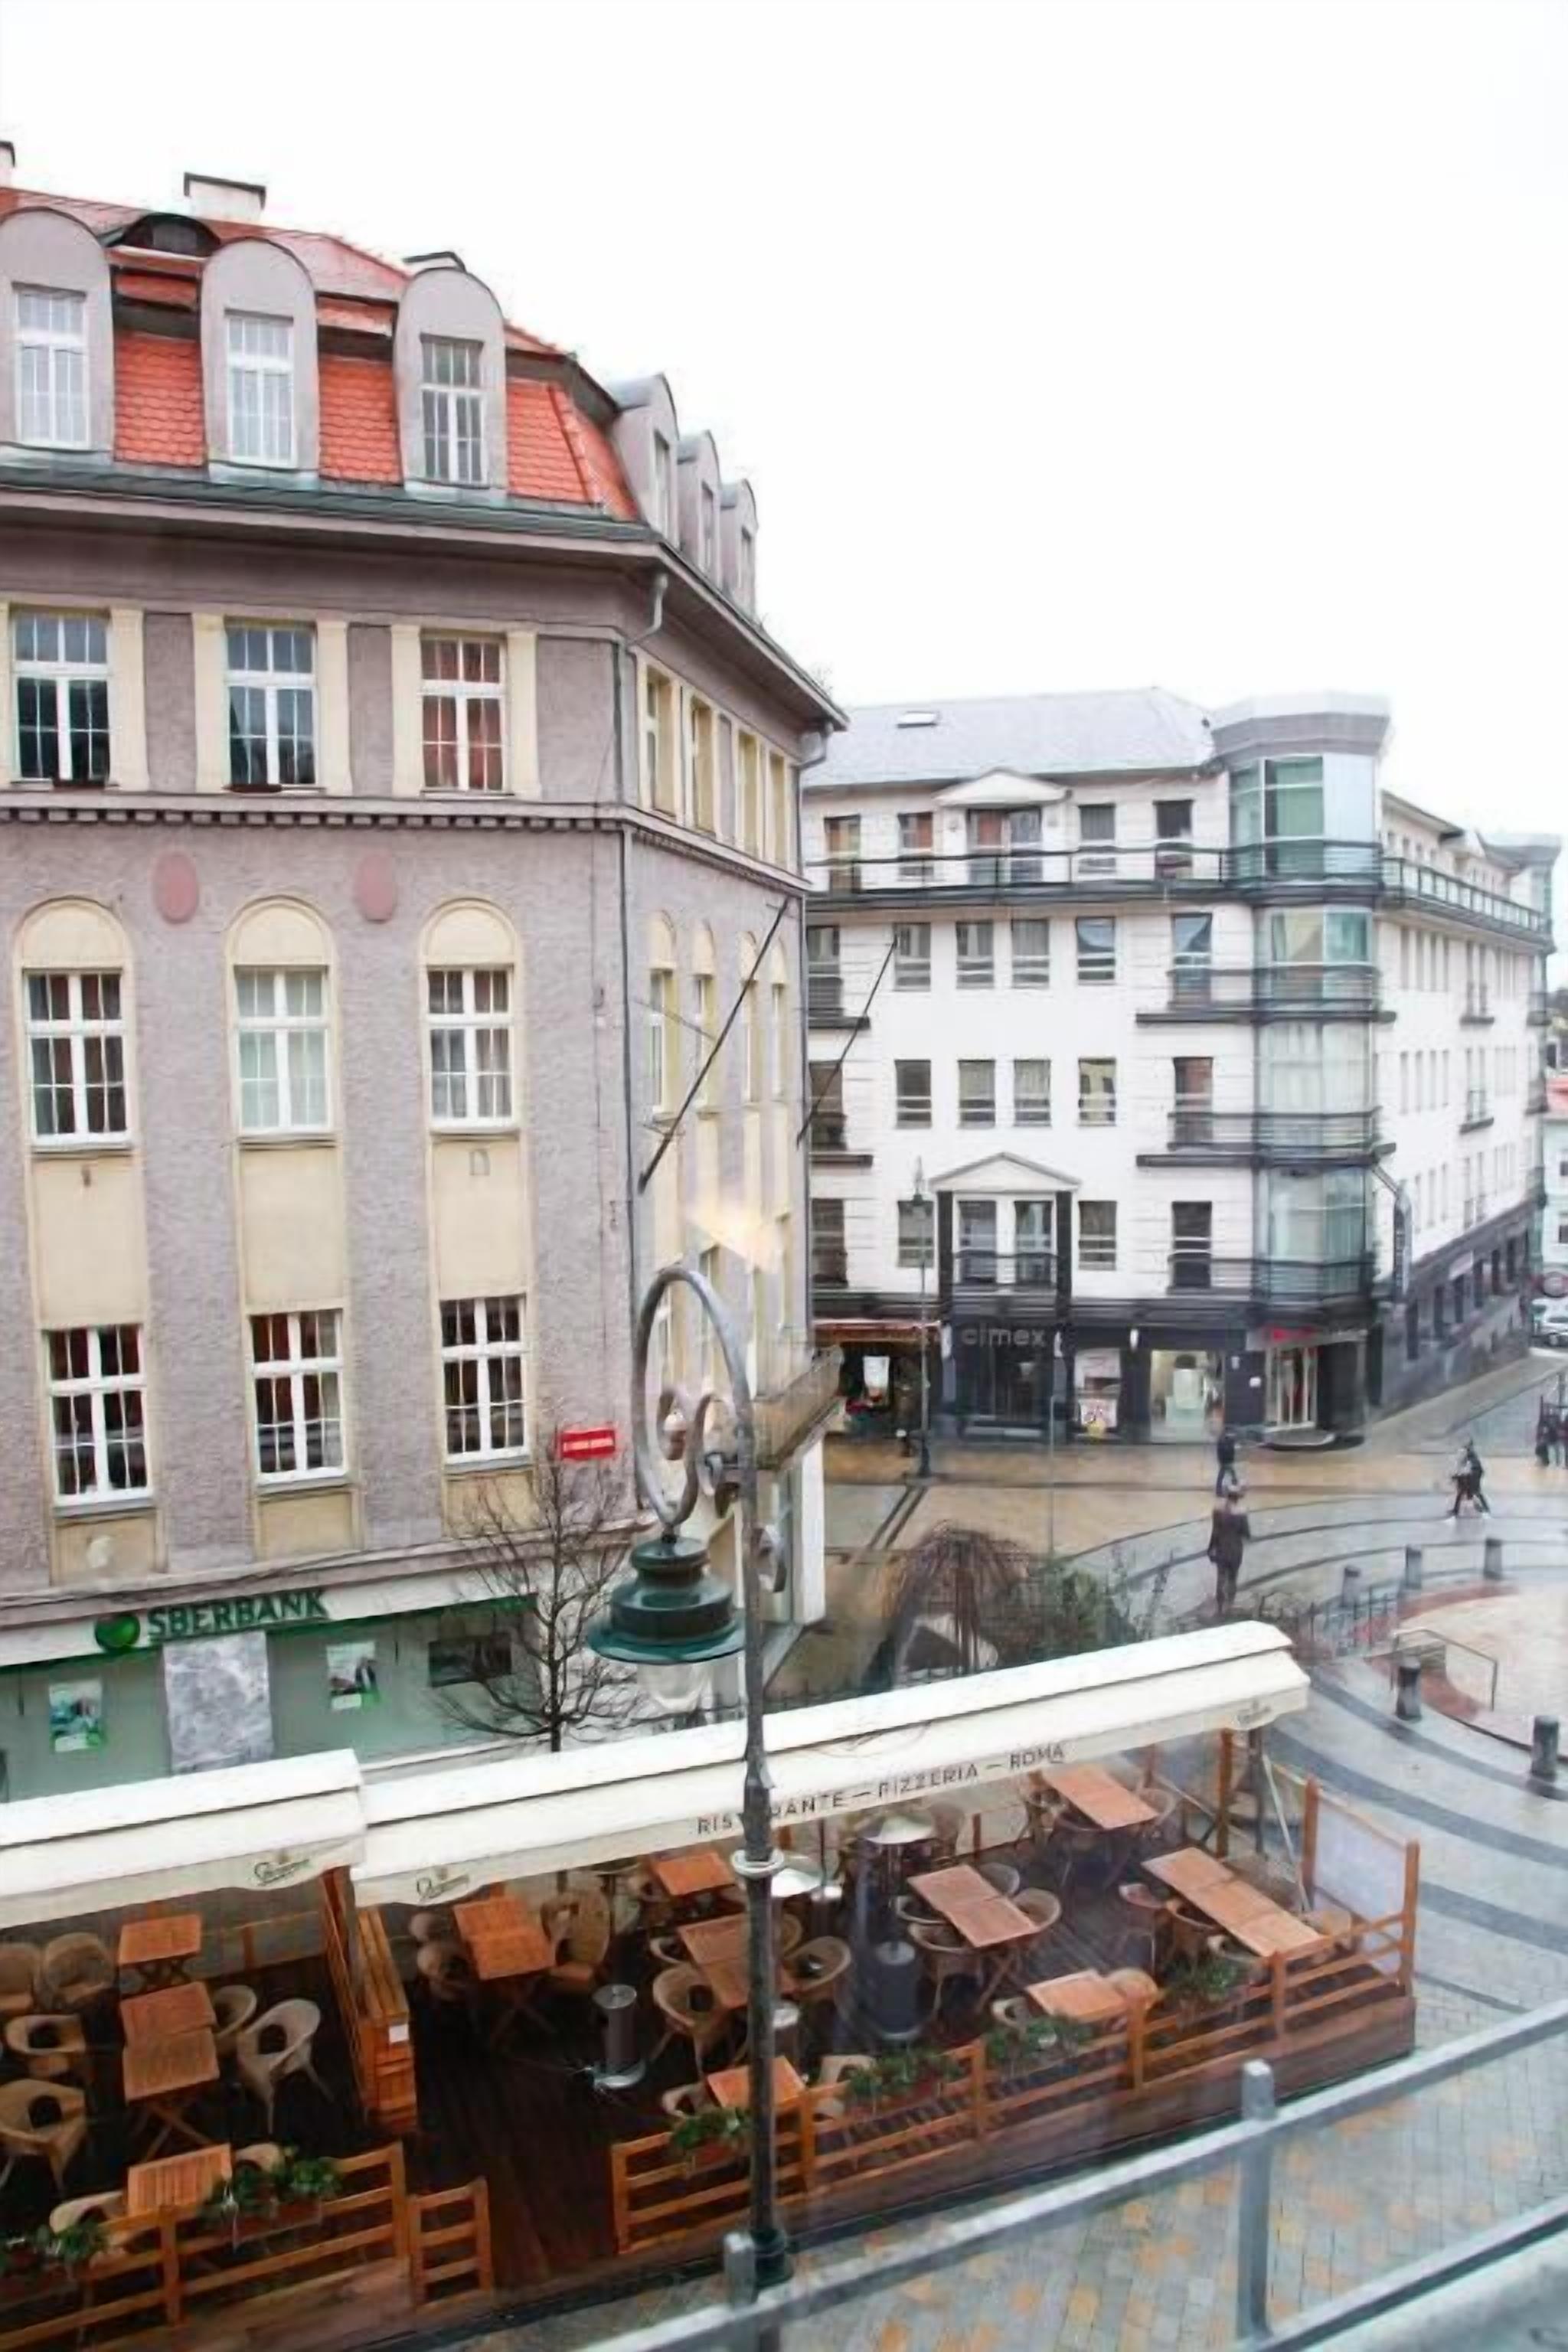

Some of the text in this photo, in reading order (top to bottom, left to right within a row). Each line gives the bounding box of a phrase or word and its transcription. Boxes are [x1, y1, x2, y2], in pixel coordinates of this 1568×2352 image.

[961, 1323, 1047, 1347] cimex
[147, 1588, 329, 1635] SBERBANK
[697, 1742, 1065, 1835] RISANTE PIZZERIA ROMA
